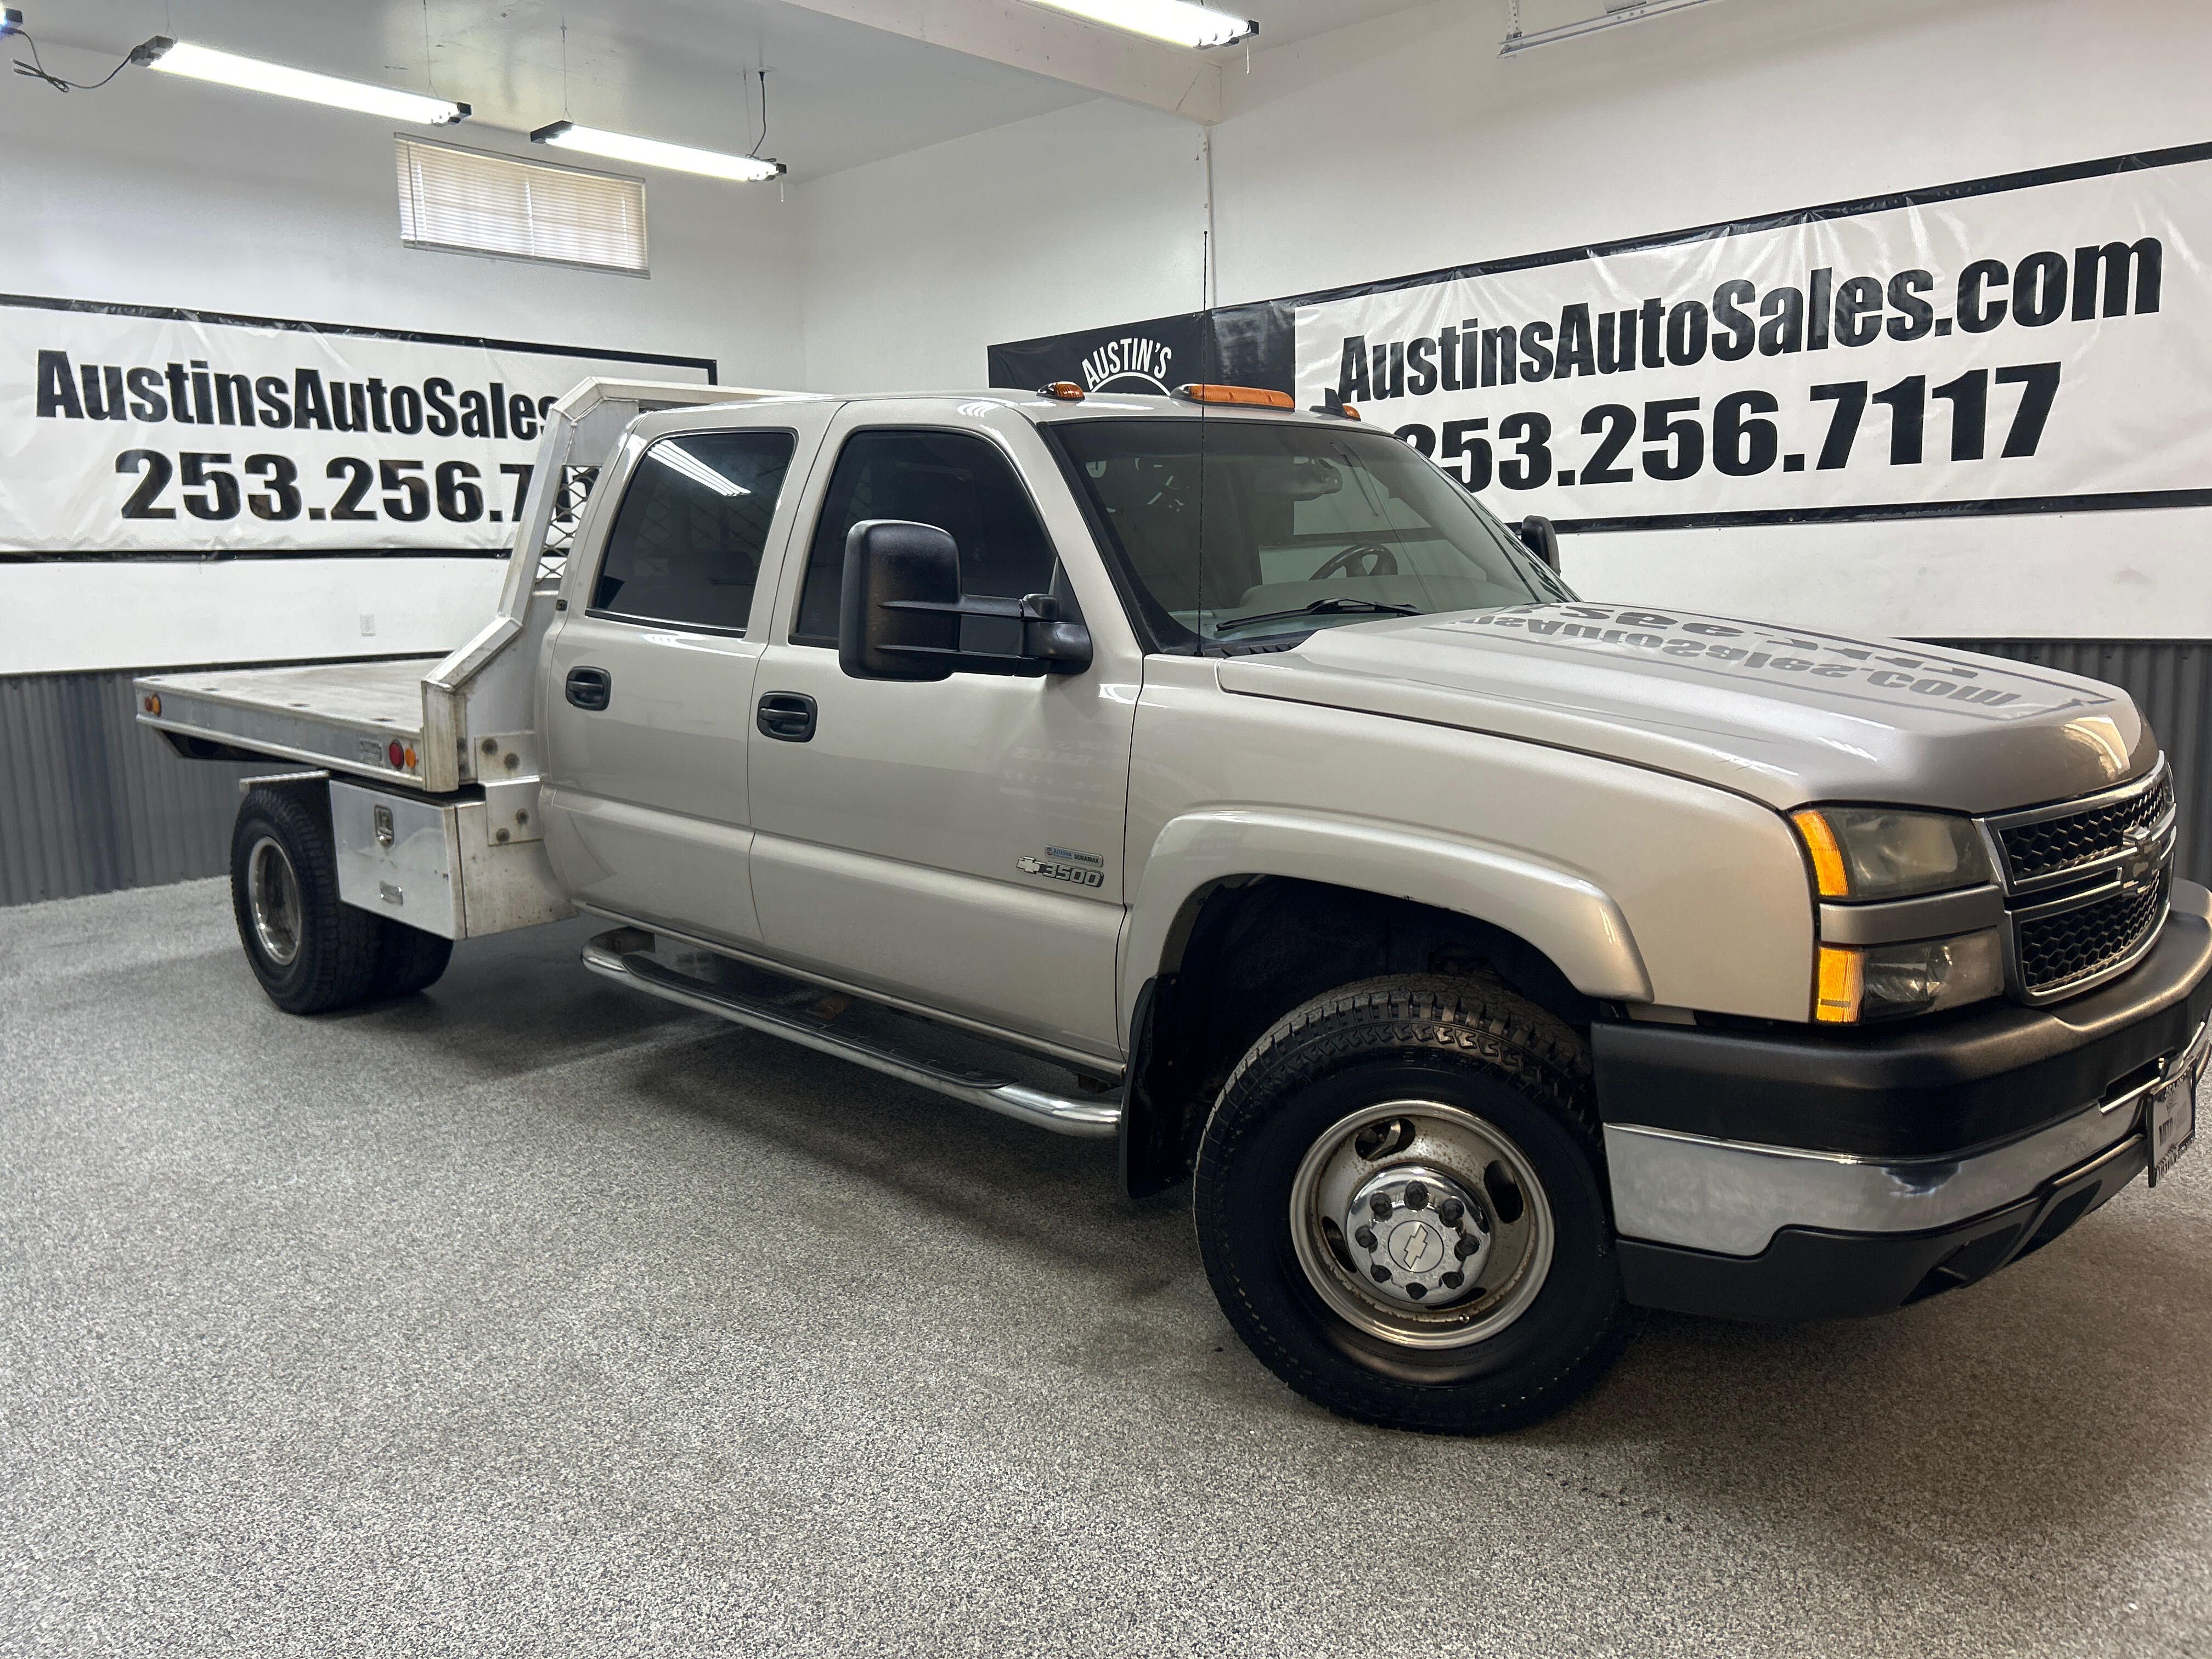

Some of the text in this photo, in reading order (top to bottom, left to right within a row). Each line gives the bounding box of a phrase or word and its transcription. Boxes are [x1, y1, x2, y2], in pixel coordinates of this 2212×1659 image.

[1338, 236, 2163, 403] AustinsAutoSales.com
[1081, 337, 1172, 391] AUSTIN'S
[1042, 862, 1104, 888] 3500
